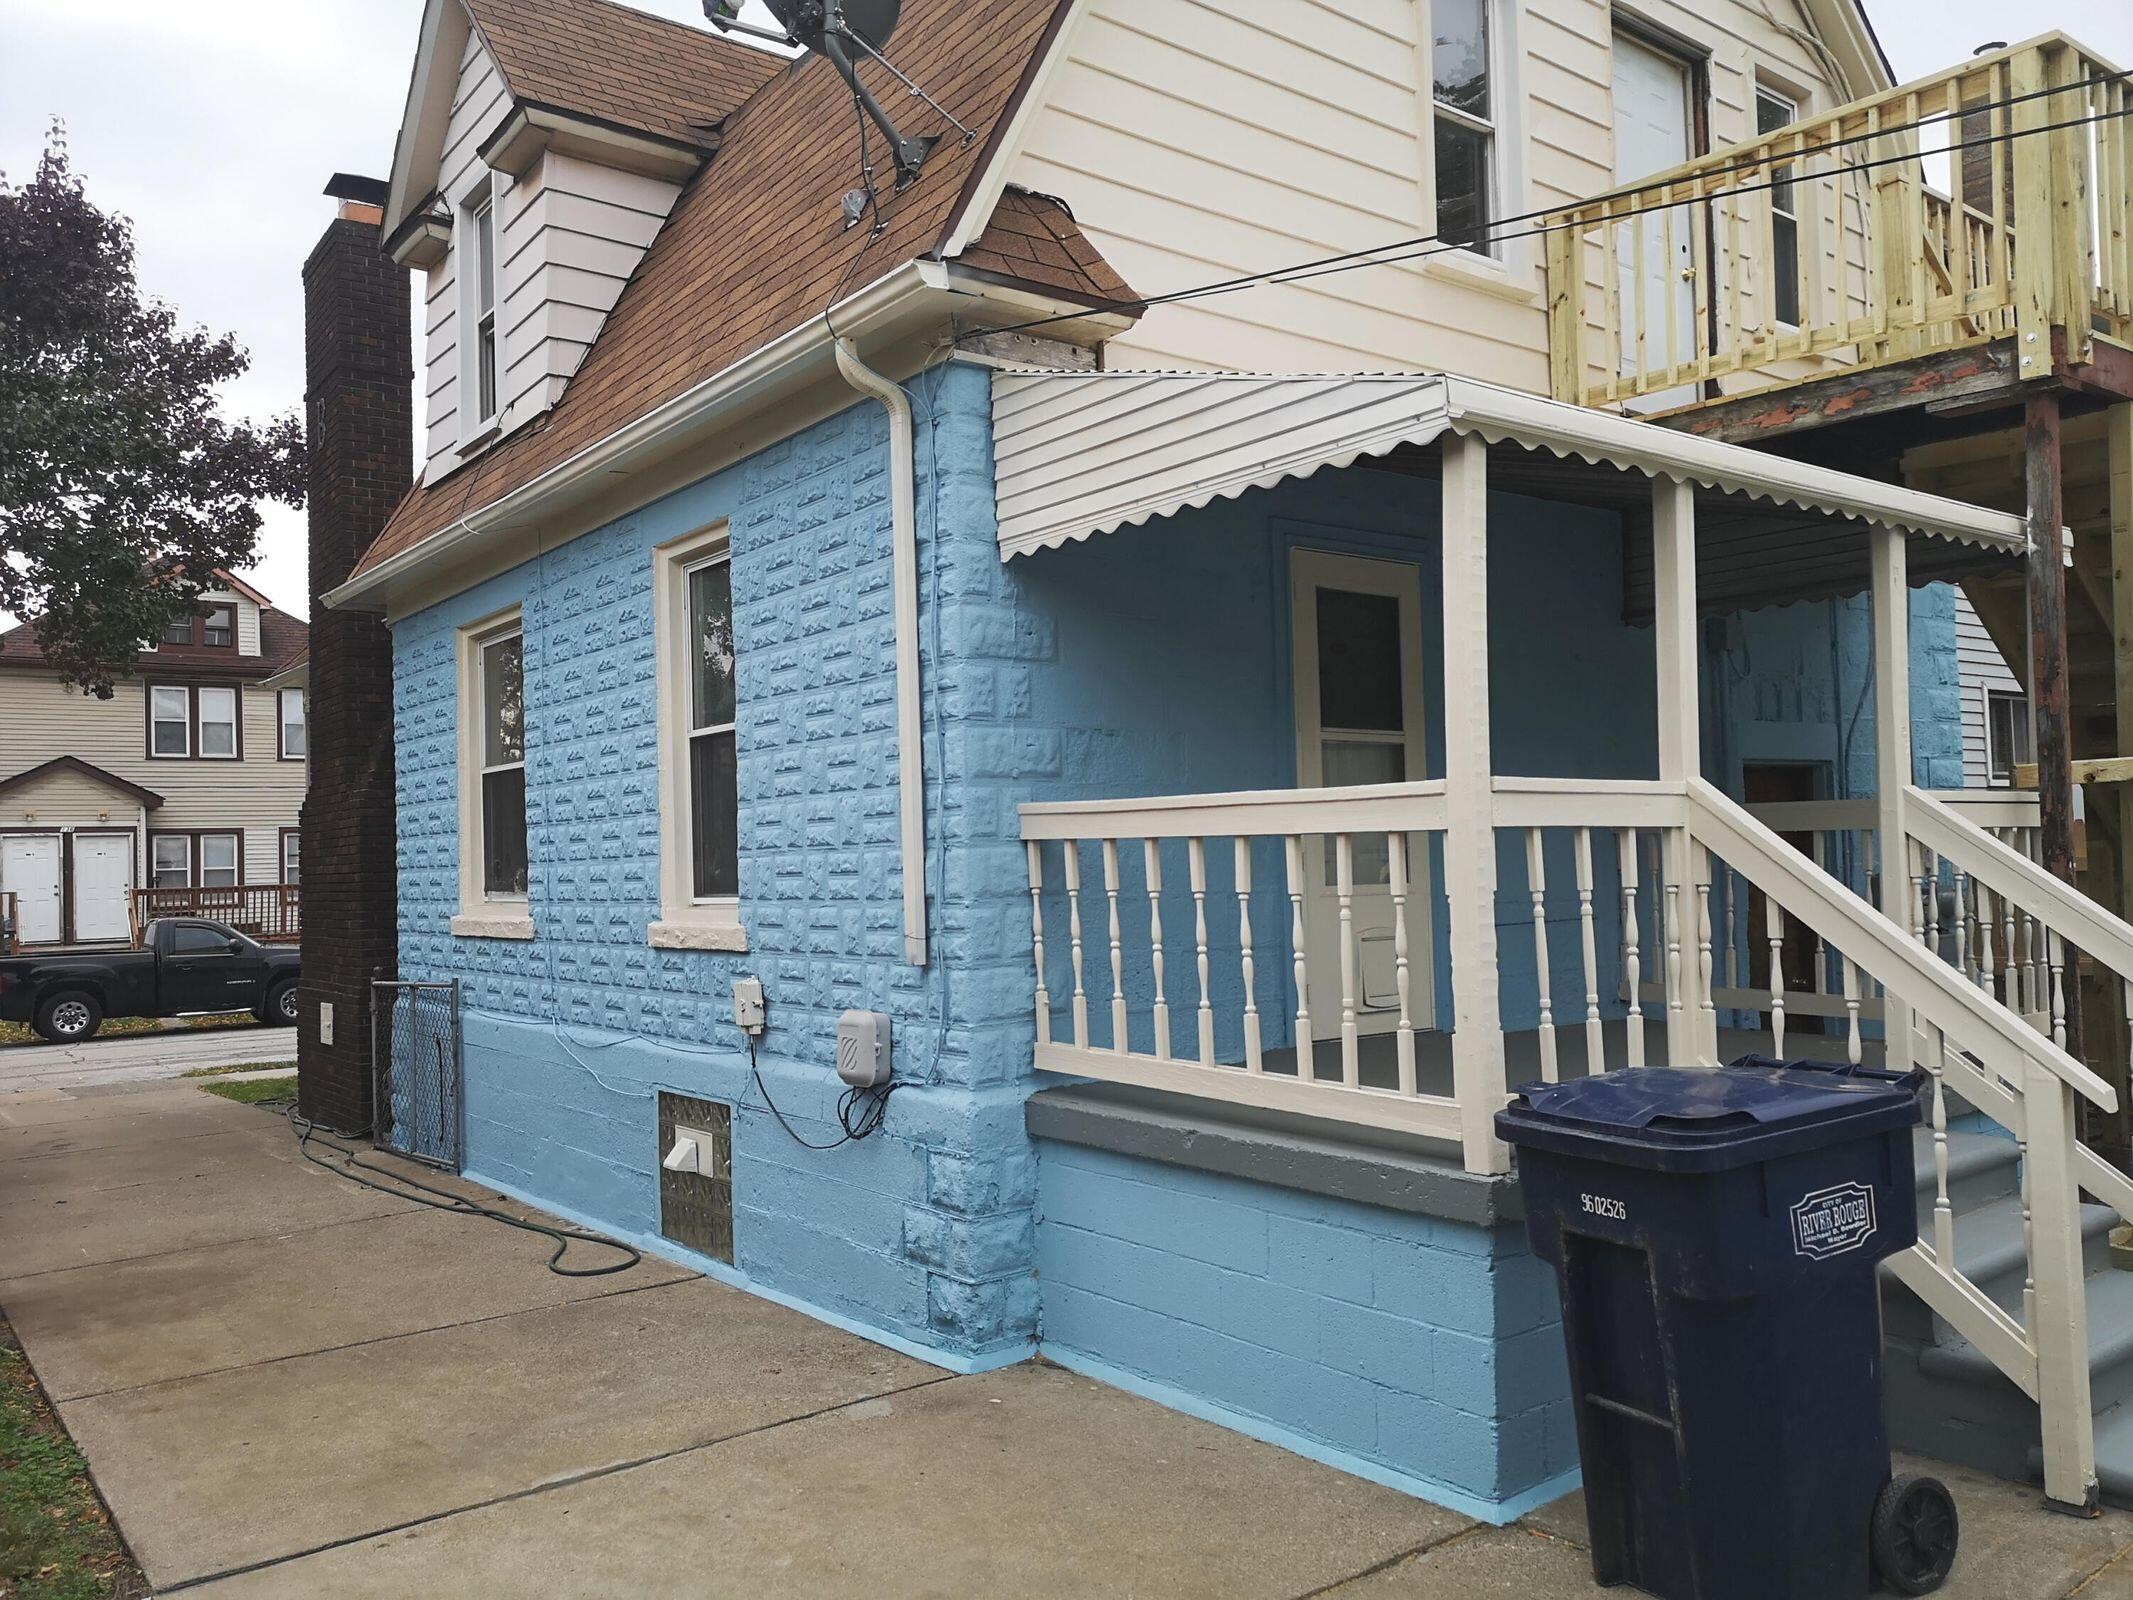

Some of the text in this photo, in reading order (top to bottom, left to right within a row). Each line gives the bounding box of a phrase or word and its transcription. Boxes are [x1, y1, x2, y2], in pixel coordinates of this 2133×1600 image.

[1822, 1200, 1834, 1209] CITY
[1801, 1199, 1866, 1236] RIVER ROUGE
[1827, 1233, 1847, 1244] Mayor
